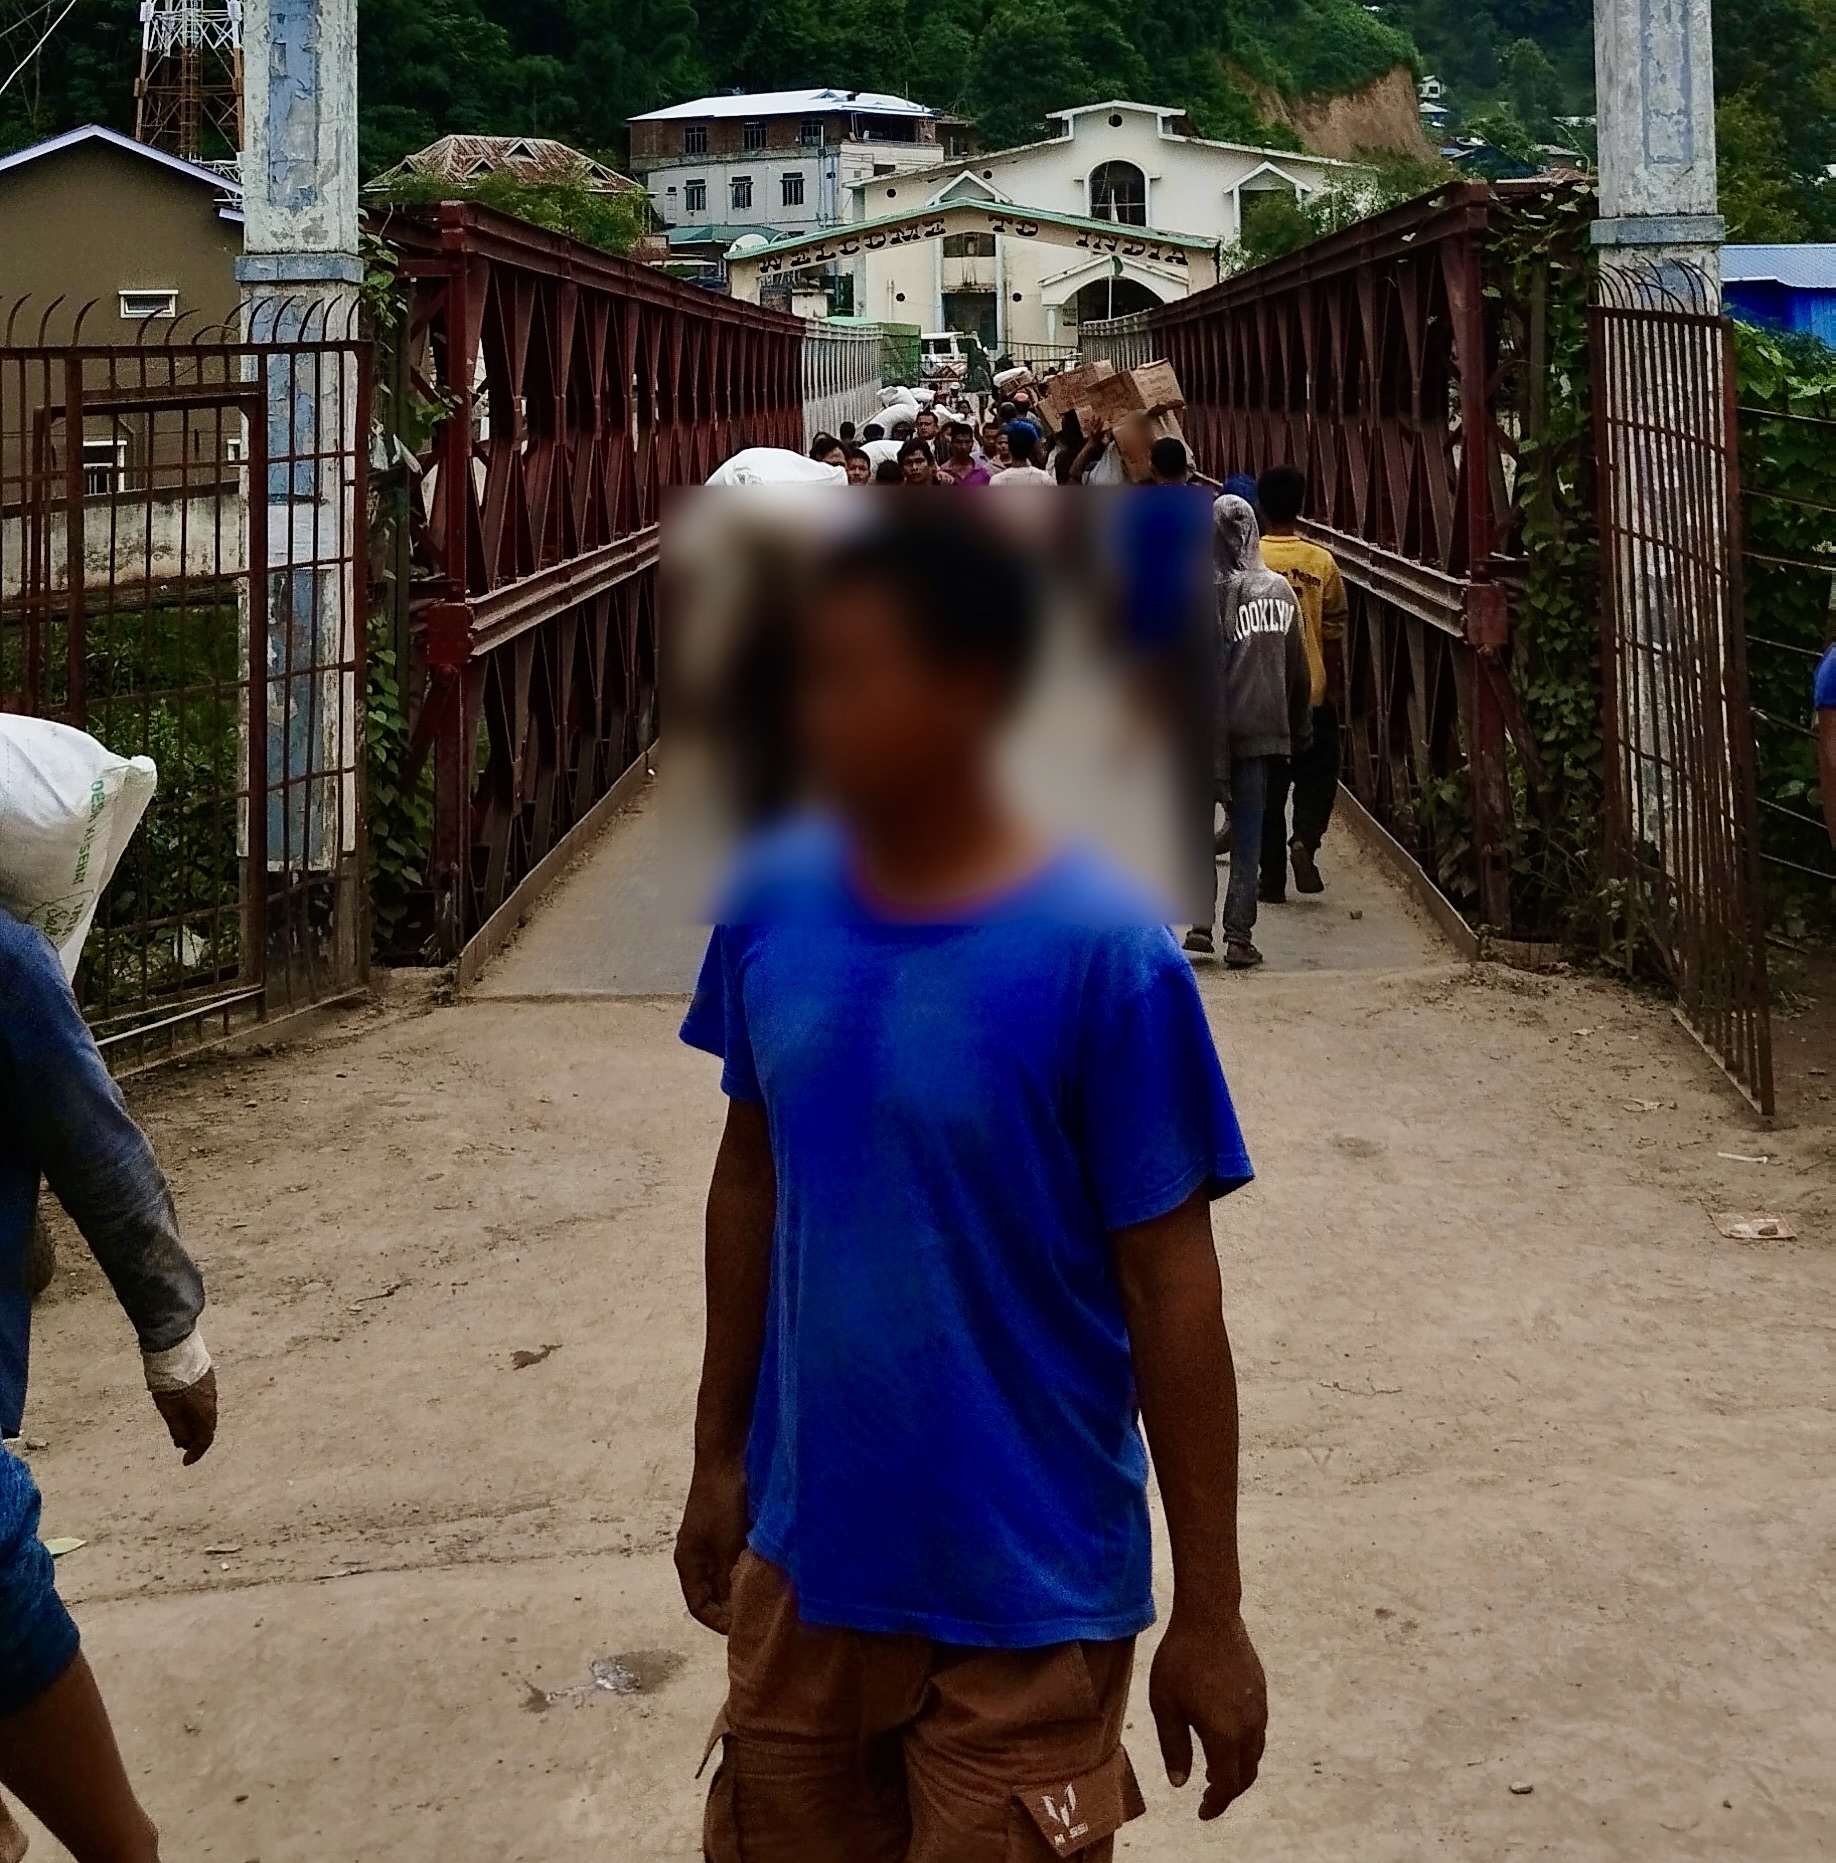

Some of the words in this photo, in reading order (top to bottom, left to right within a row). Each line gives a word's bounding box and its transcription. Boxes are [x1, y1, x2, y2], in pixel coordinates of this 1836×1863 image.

[757, 217, 948, 274] WELCOME
[987, 213, 1040, 238] TO
[1075, 229, 1189, 266] INDIA
